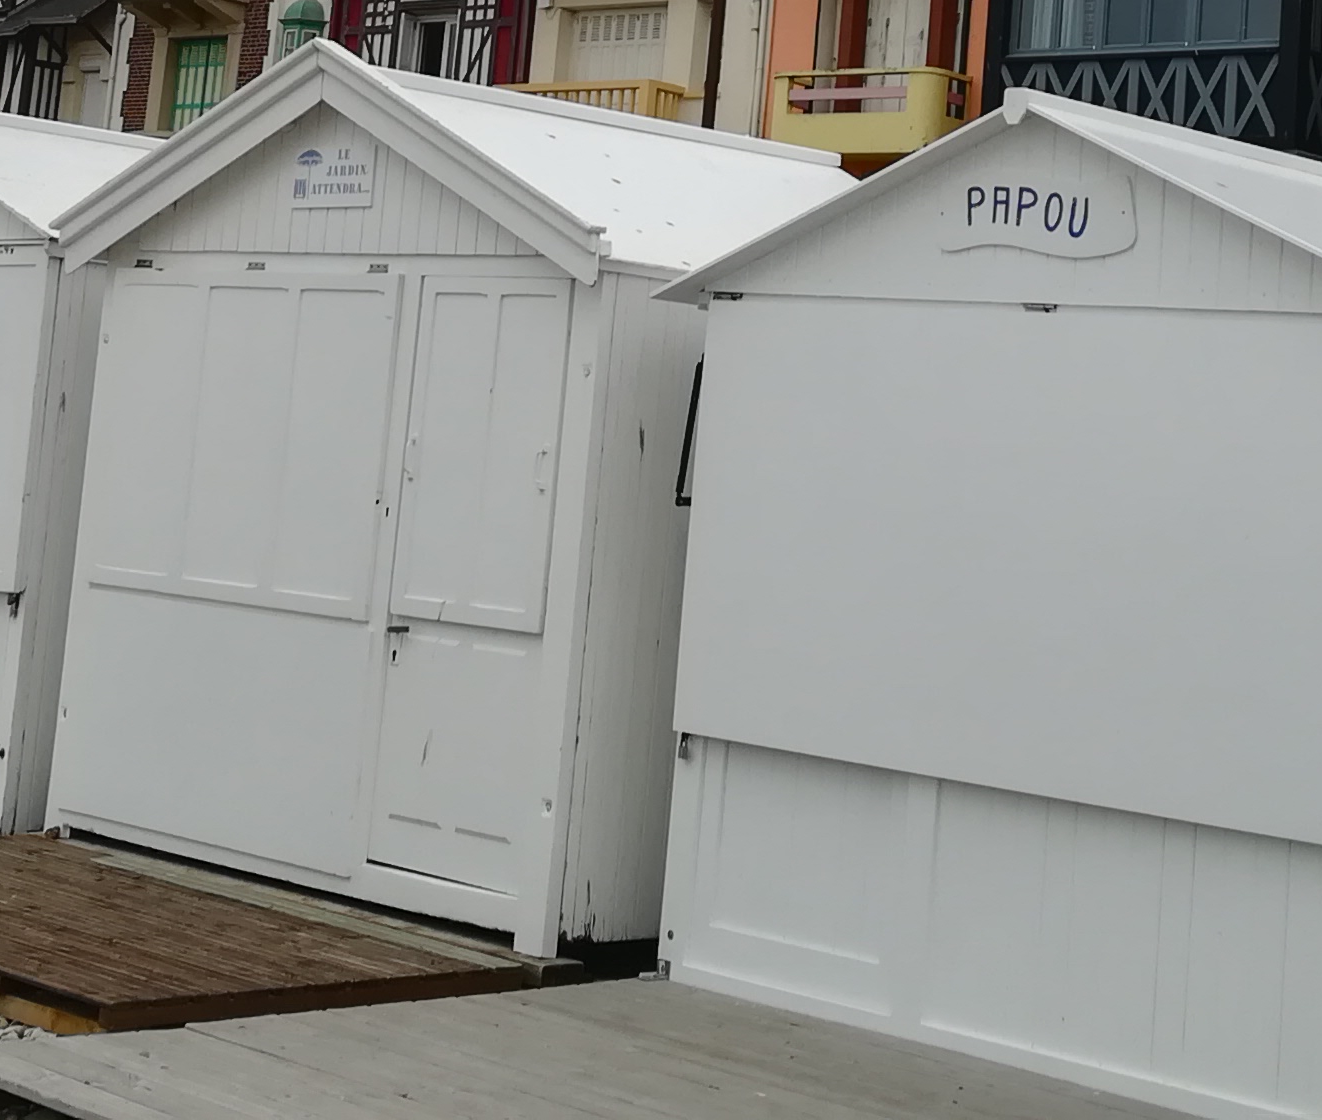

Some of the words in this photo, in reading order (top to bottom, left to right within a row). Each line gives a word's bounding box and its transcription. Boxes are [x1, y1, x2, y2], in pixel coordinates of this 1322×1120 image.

[337, 148, 351, 160] LE
[326, 164, 368, 177] JARDIN
[967, 186, 1089, 238] PAPOU
